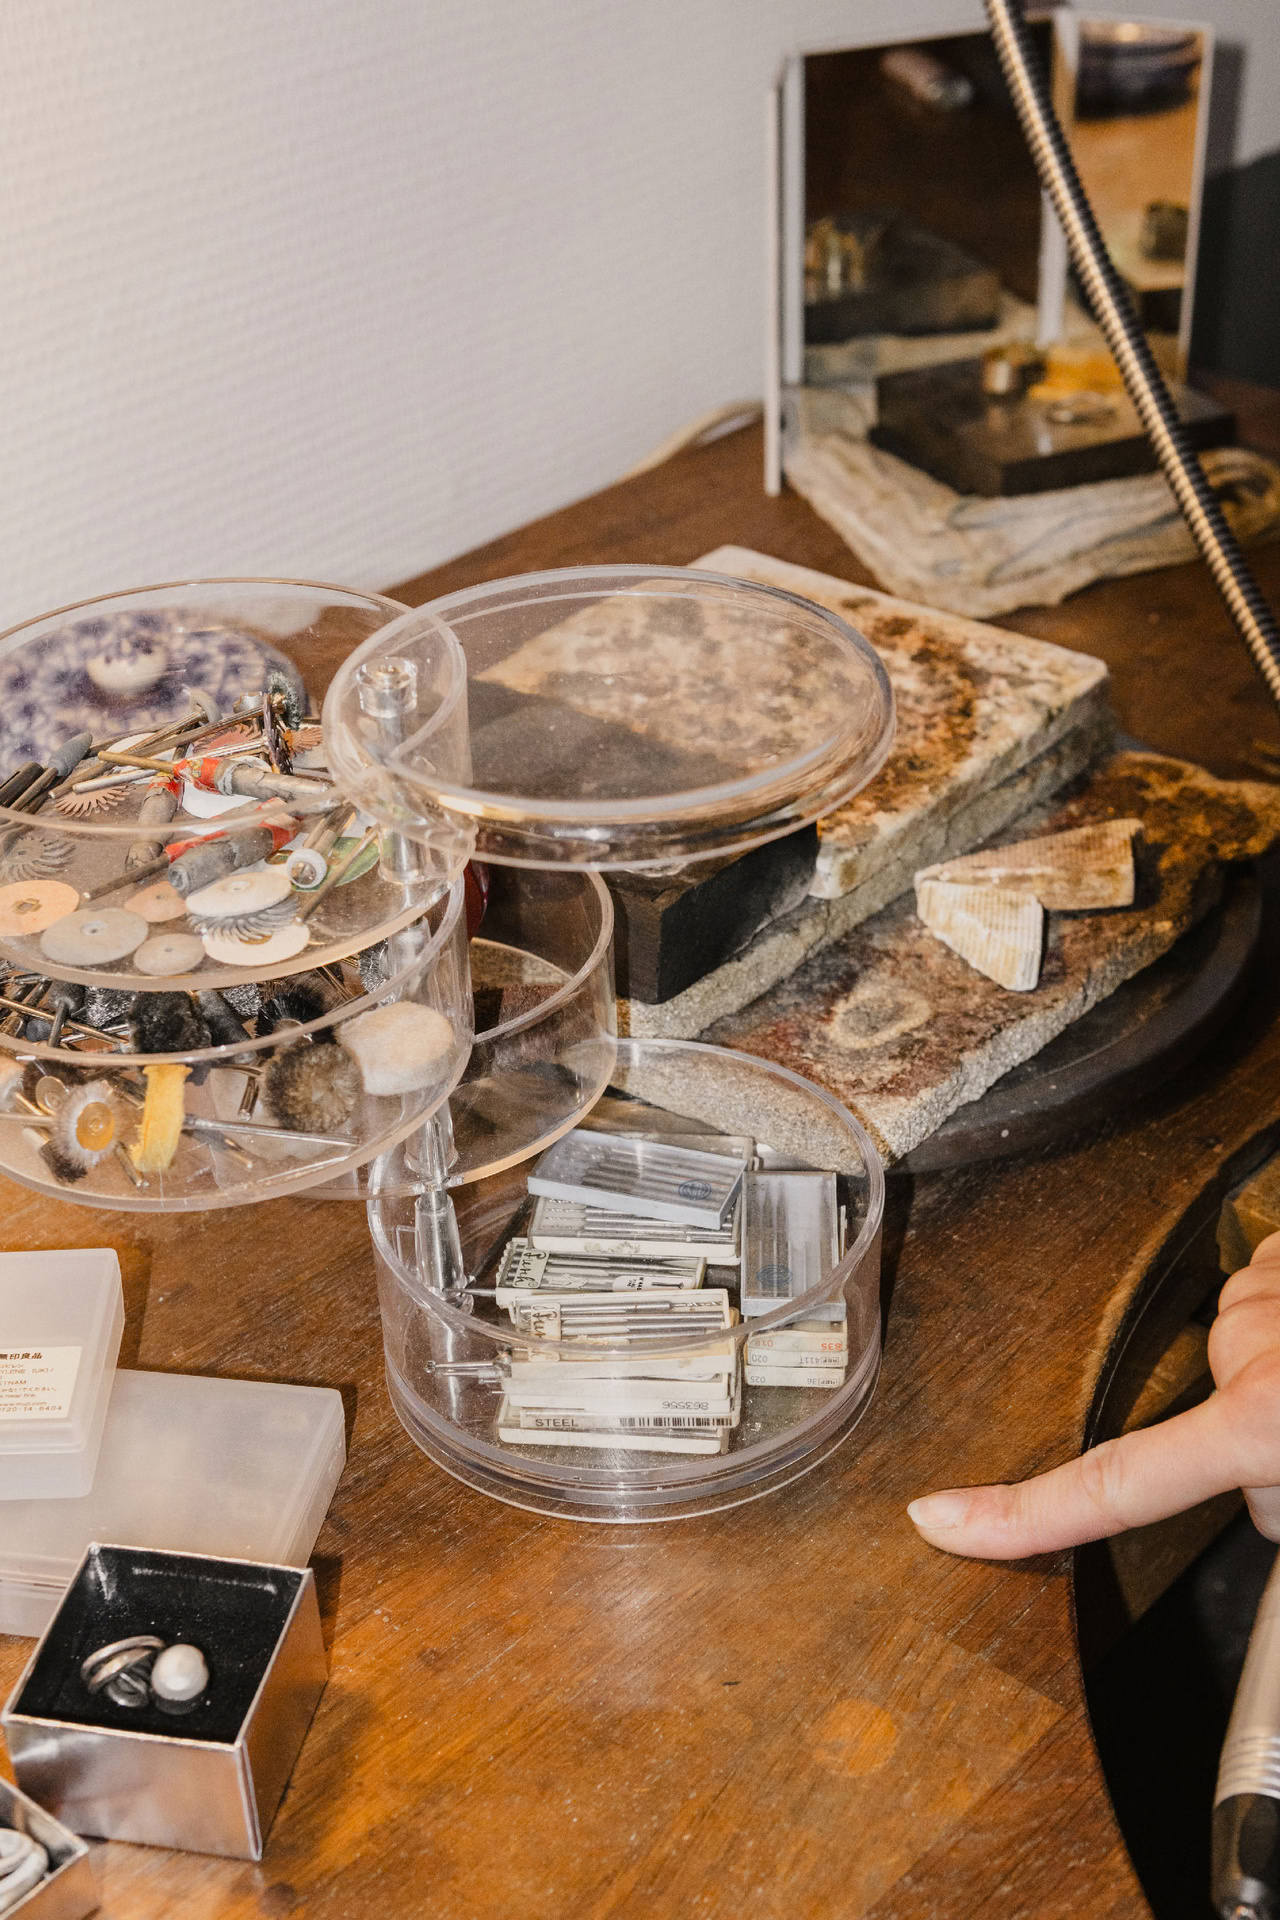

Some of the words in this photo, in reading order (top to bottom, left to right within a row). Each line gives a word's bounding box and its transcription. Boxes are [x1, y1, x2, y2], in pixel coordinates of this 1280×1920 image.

[751, 1354, 768, 1363] 020
[750, 1375, 766, 1384] 025
[662, 1401, 709, 1410] 863556
[535, 1418, 579, 1427] STEEL
